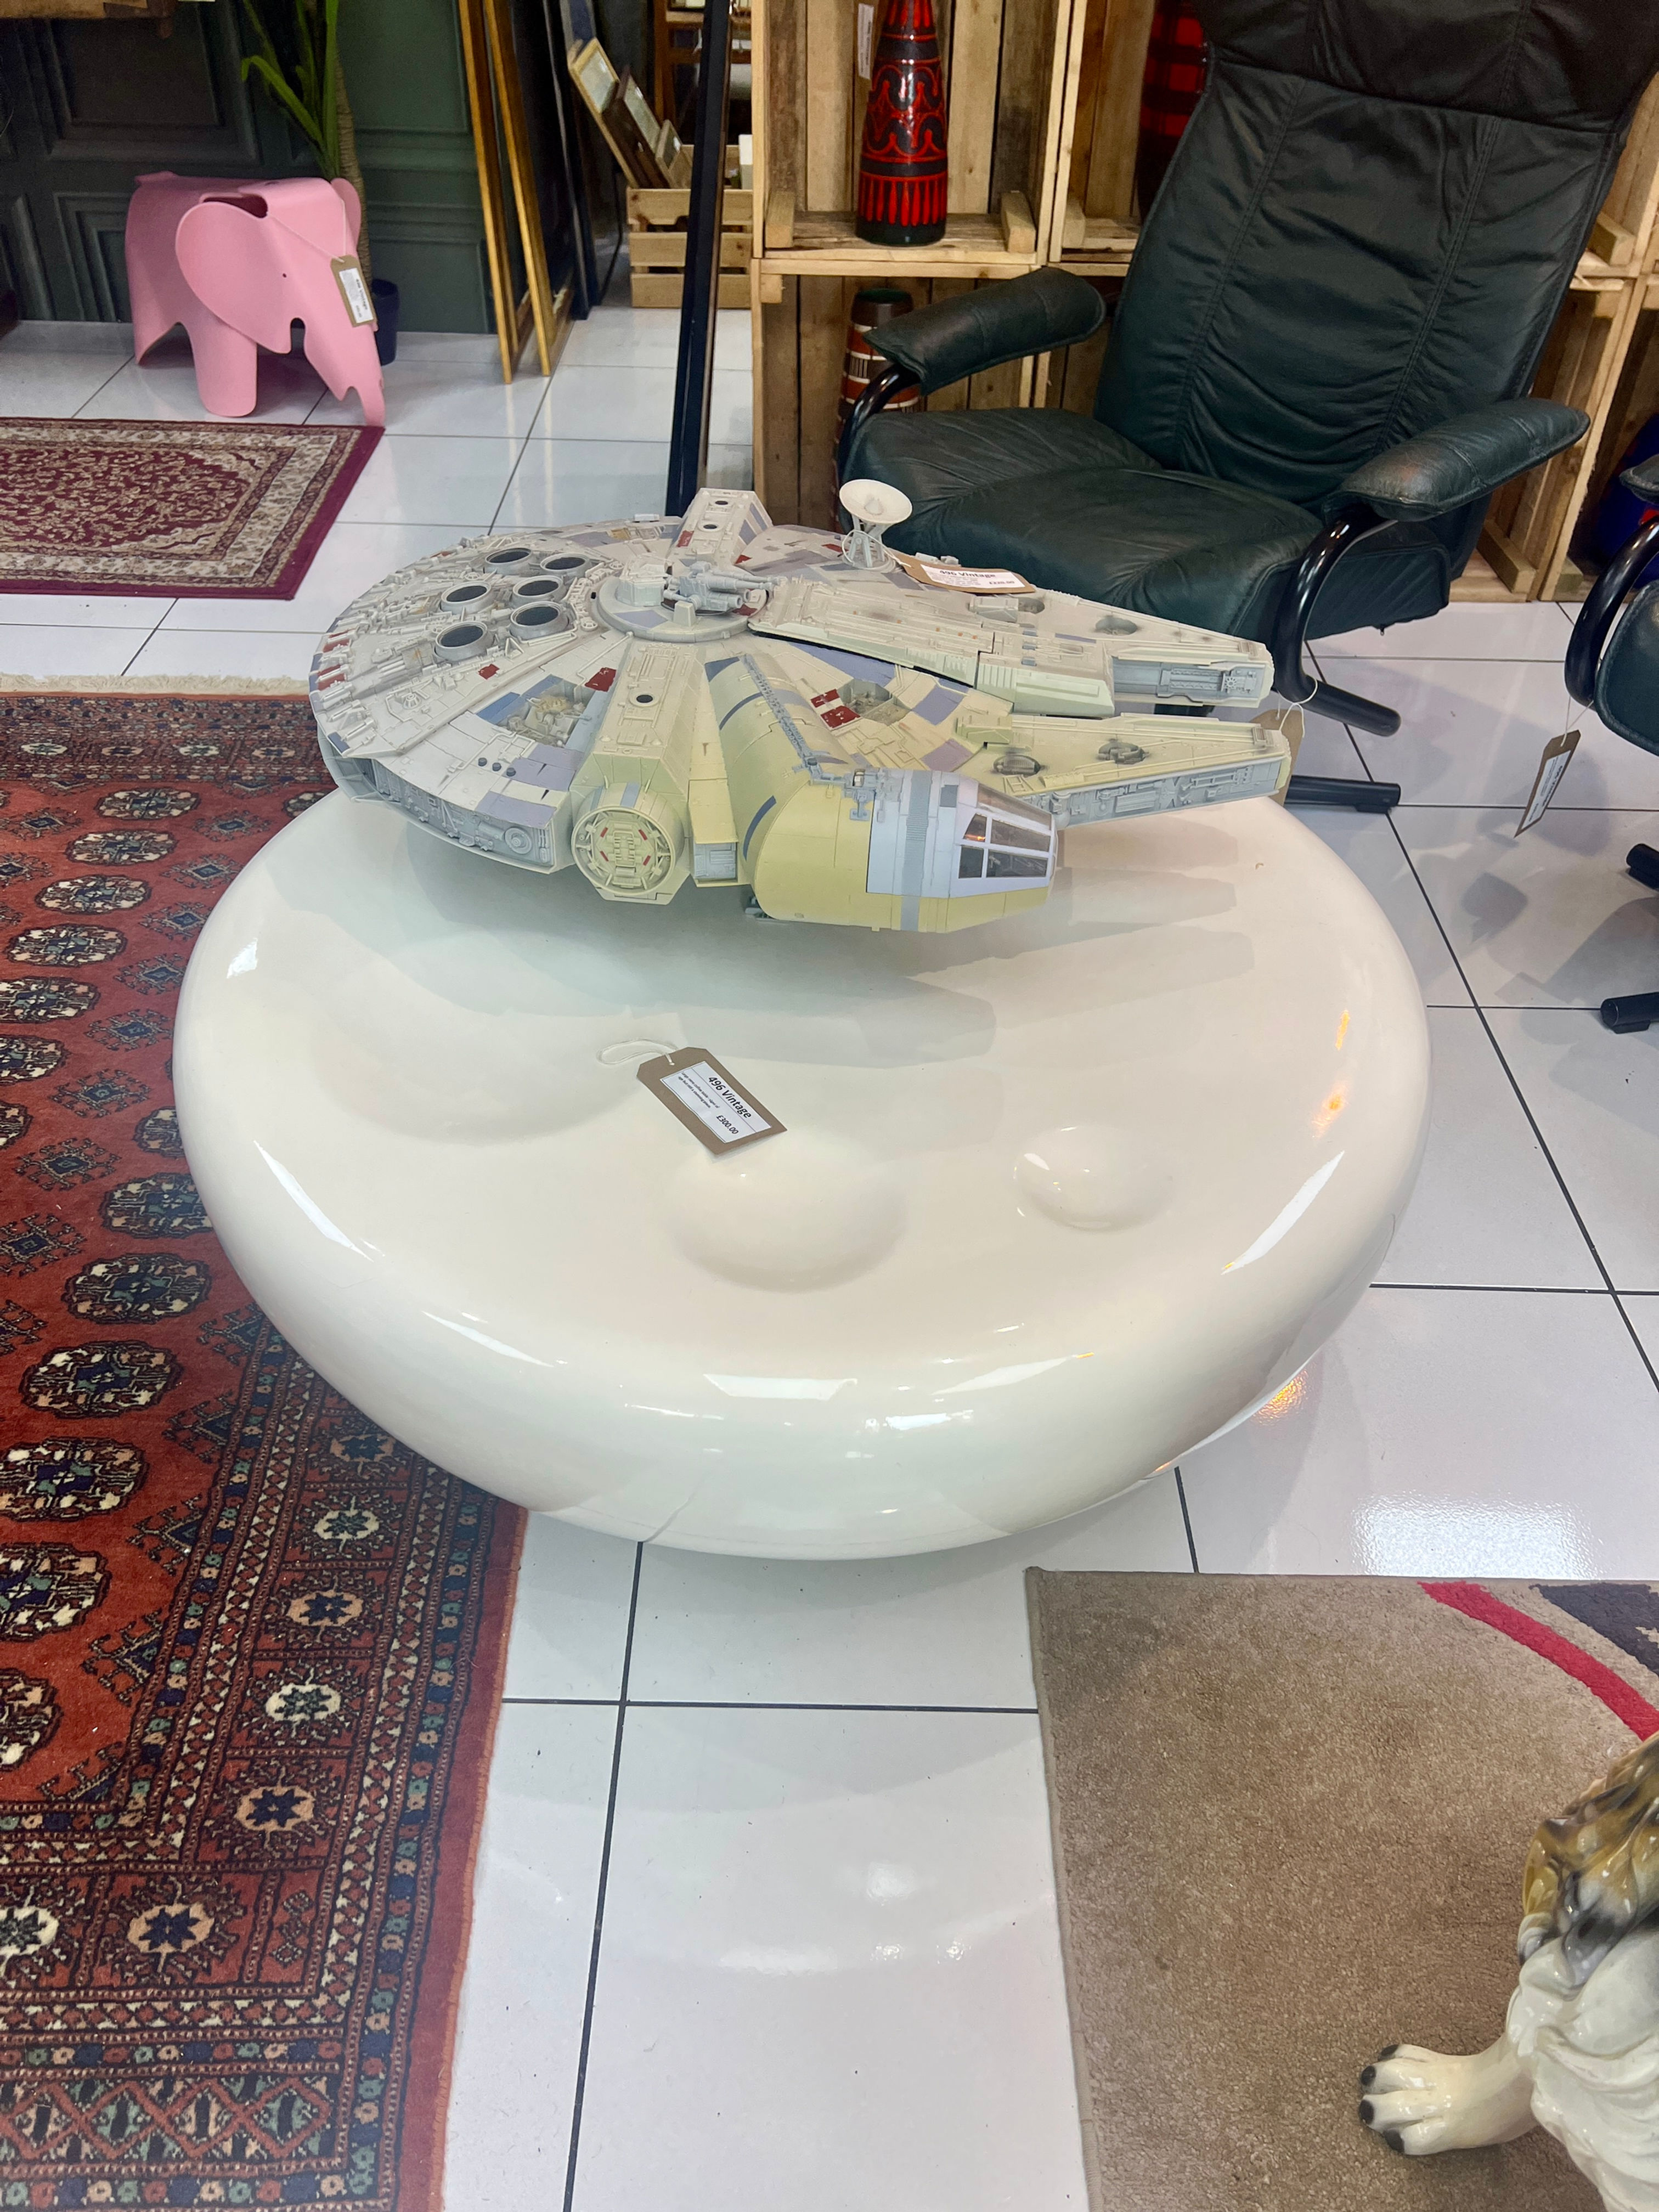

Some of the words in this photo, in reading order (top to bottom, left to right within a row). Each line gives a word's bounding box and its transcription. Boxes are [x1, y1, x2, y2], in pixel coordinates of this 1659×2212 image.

[708, 1076, 725, 1091] 496
[722, 1090, 752, 1119] Vintage
[716, 1114, 739, 1135] £300.00
